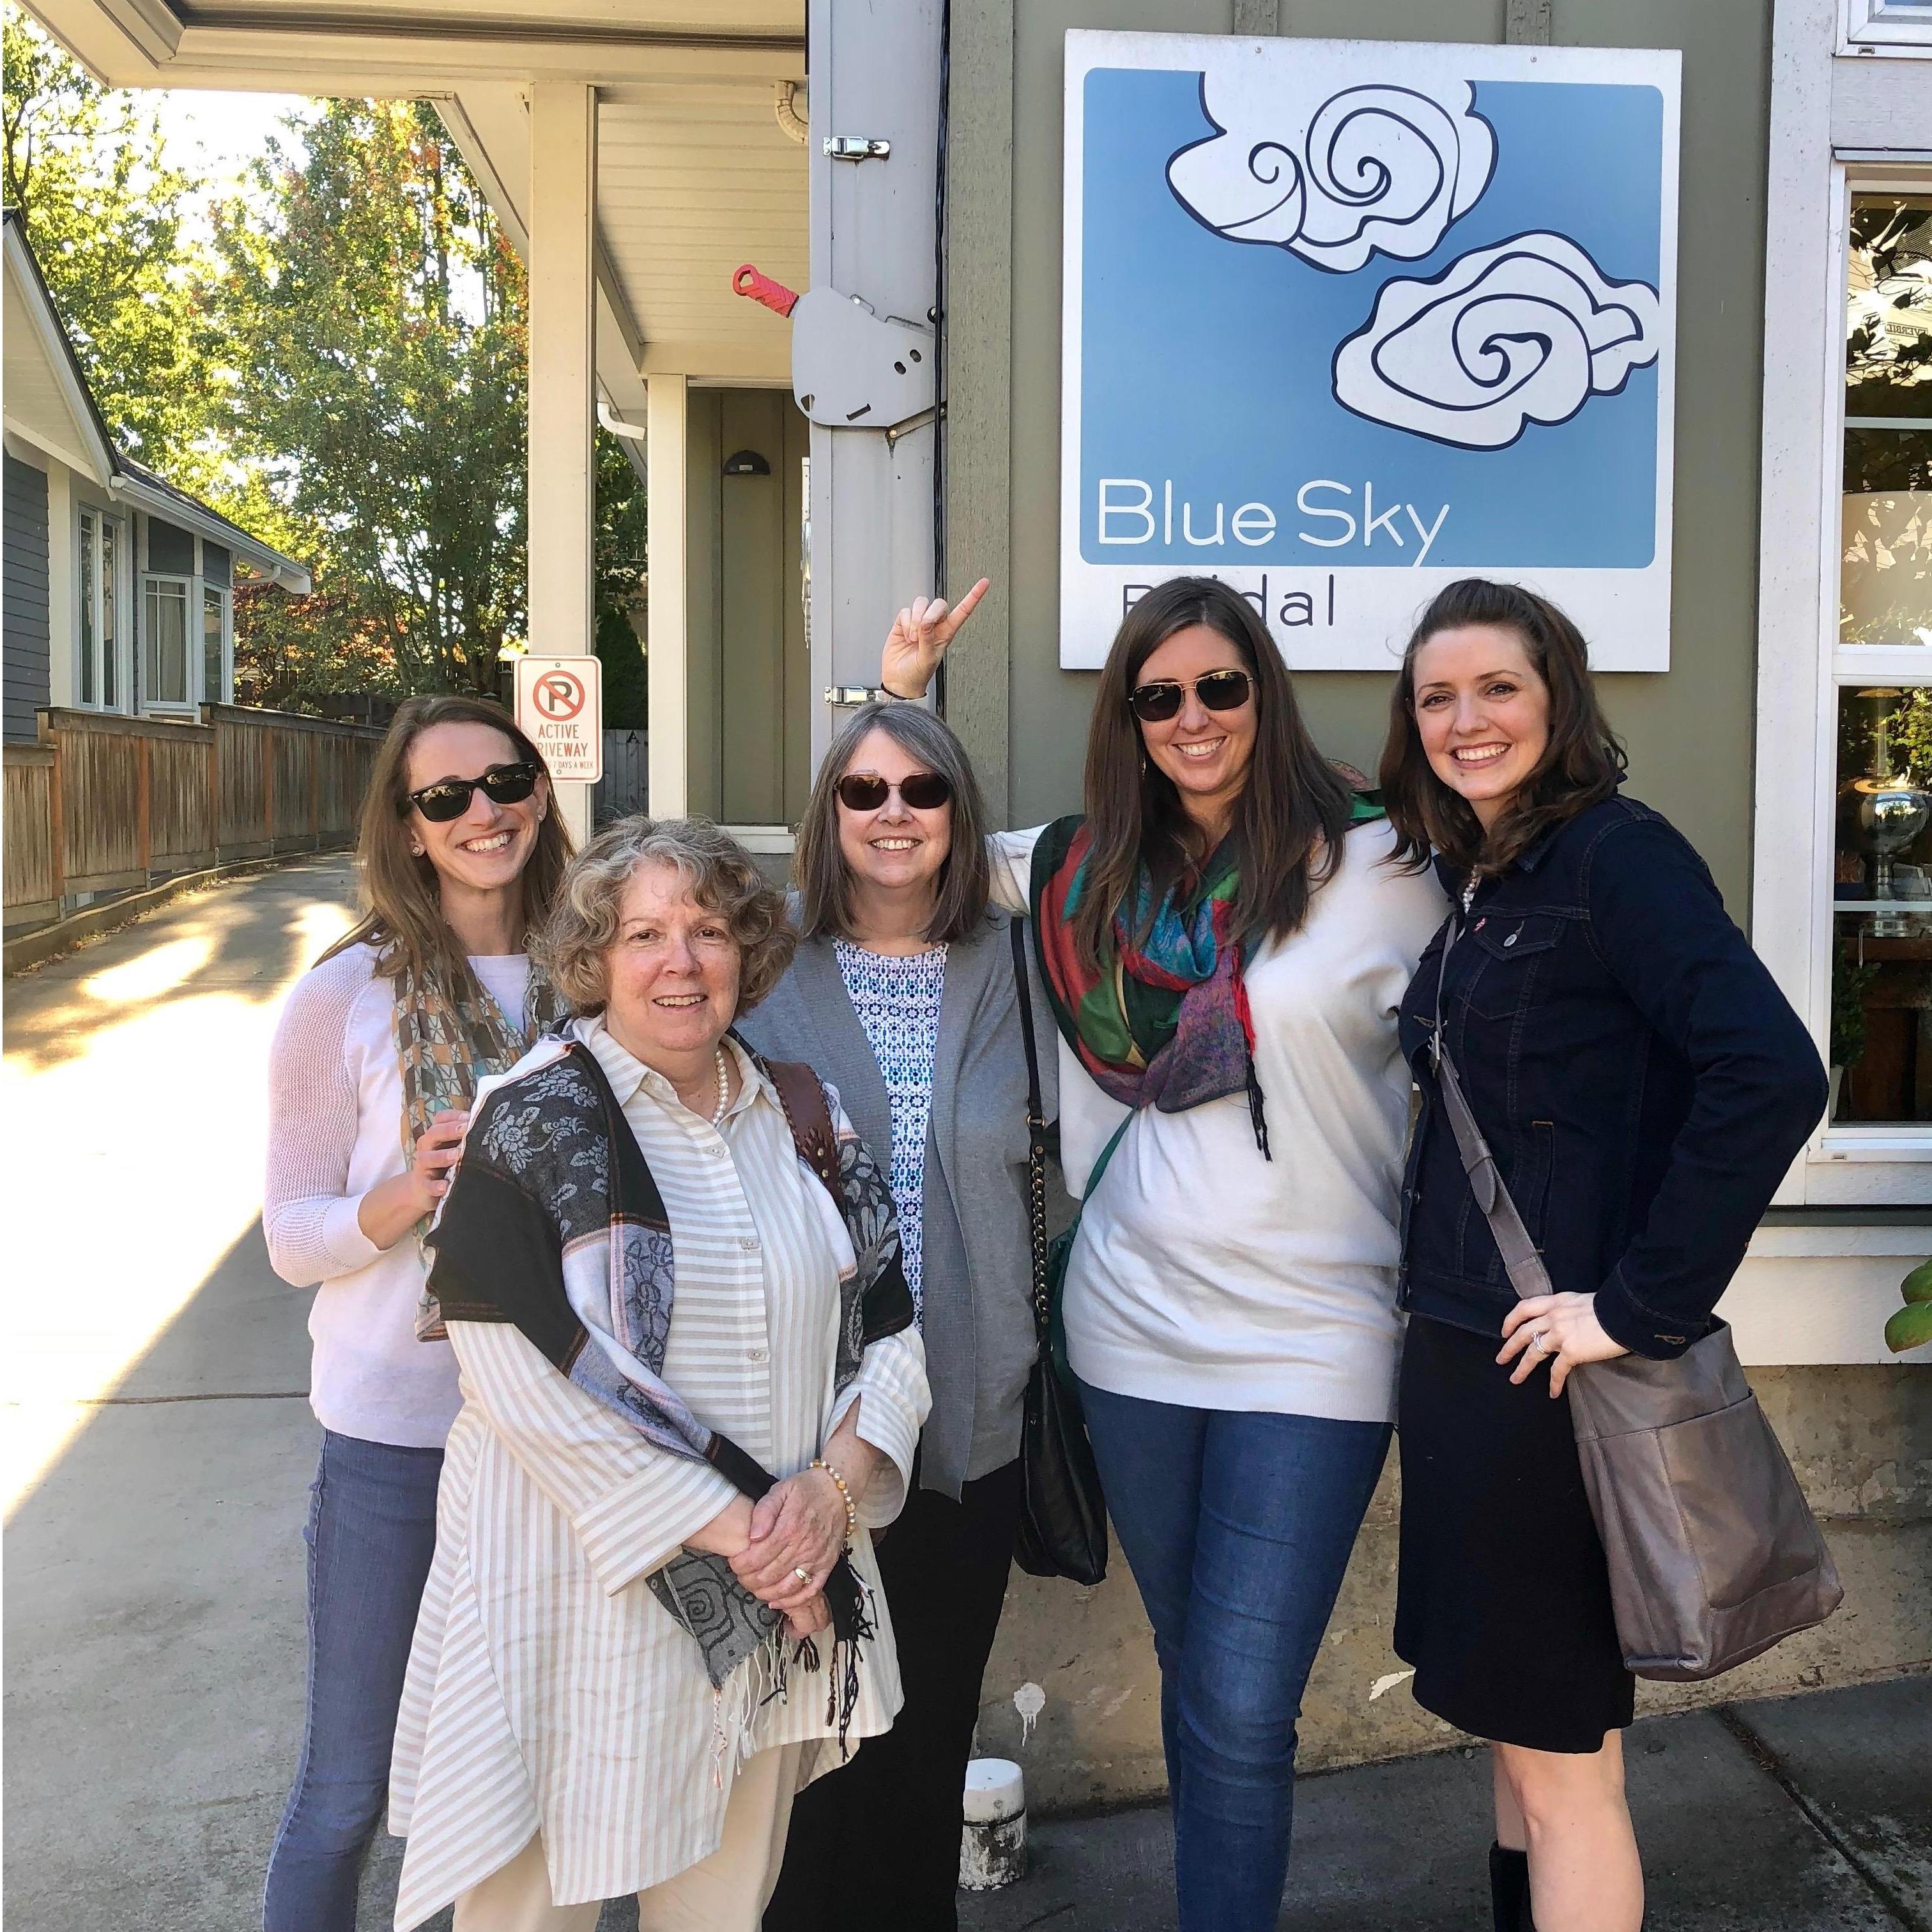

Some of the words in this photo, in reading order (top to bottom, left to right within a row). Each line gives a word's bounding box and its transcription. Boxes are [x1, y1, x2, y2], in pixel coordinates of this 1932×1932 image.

[1098, 478, 1276, 546] Blue
[1296, 479, 1450, 567] Sky
[1123, 572, 1335, 626] dal
[538, 724, 579, 739] ACTIVE
[537, 742, 588, 757] RIVEWAY
[558, 761, 572, 769] DAYS
[574, 761, 578, 769] A
[579, 761, 594, 769] WEEK
